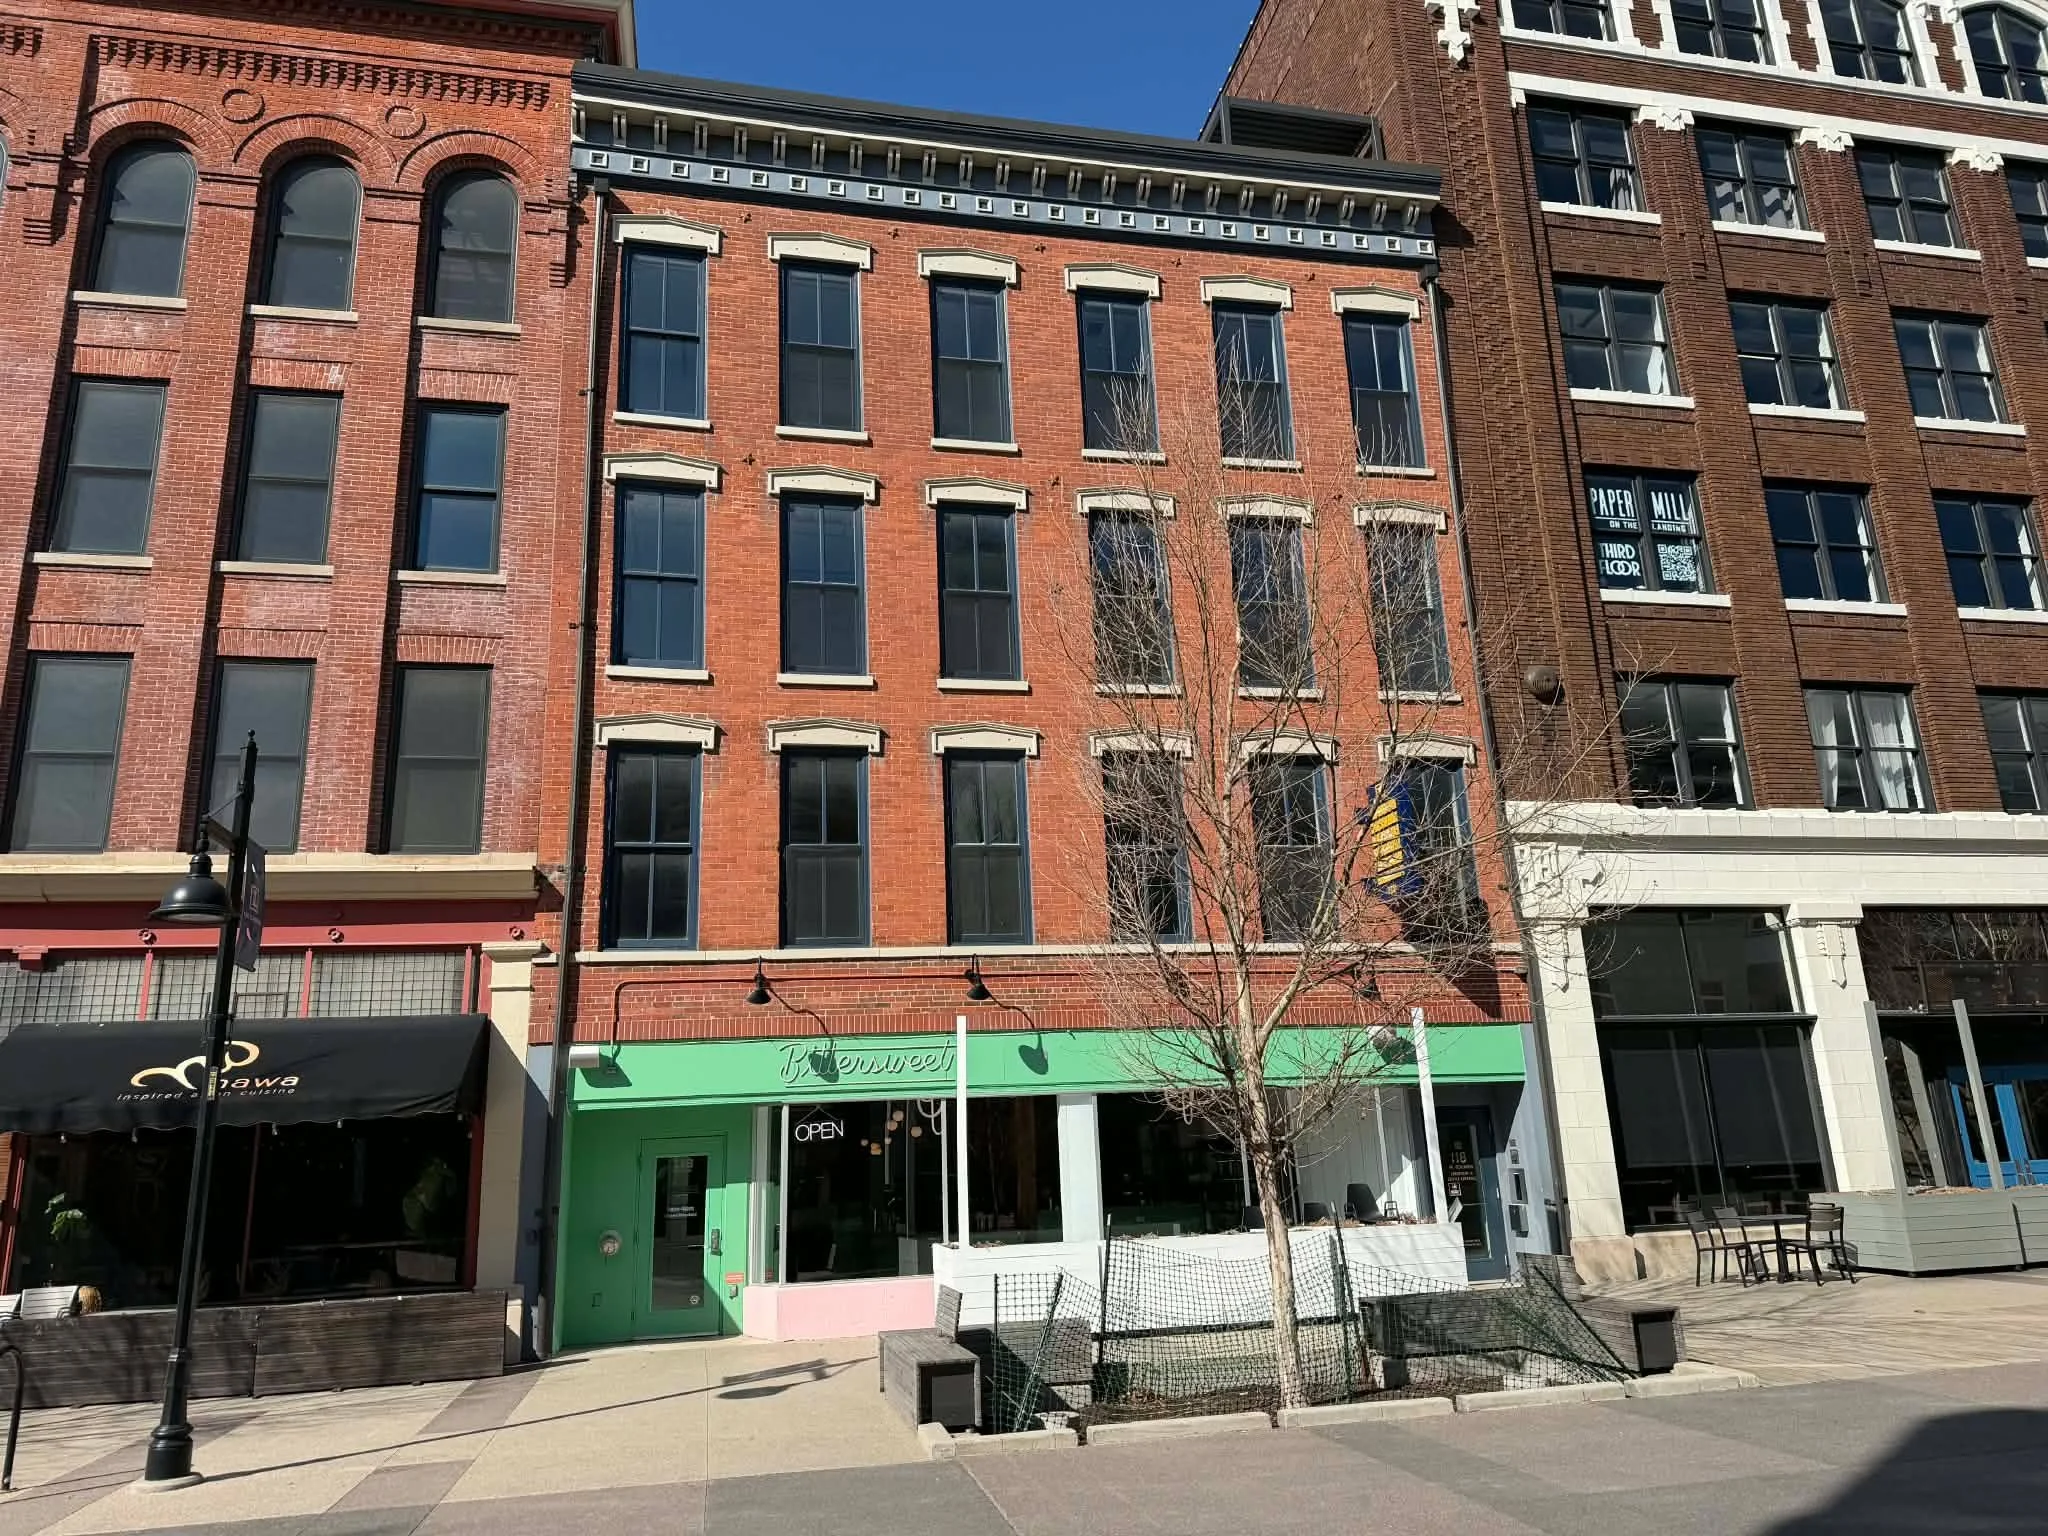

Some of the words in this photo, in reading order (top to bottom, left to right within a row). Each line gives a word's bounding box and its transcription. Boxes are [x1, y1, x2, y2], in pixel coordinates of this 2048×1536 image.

[1589, 487, 1635, 518] PAPER
[1650, 491, 1690, 521] MILL
[1609, 520, 1620, 529] ON
[1623, 521, 1638, 530] THE
[1651, 523, 1687, 533] LANDING
[1599, 542, 1636, 560] THIRD
[1600, 559, 1641, 577] FLOOR
[780, 1040, 955, 1084] Bittersweet
[117, 1091, 183, 1101] inspired
[239, 1088, 296, 1096] cuisine
[795, 1119, 844, 1142] OPEN
